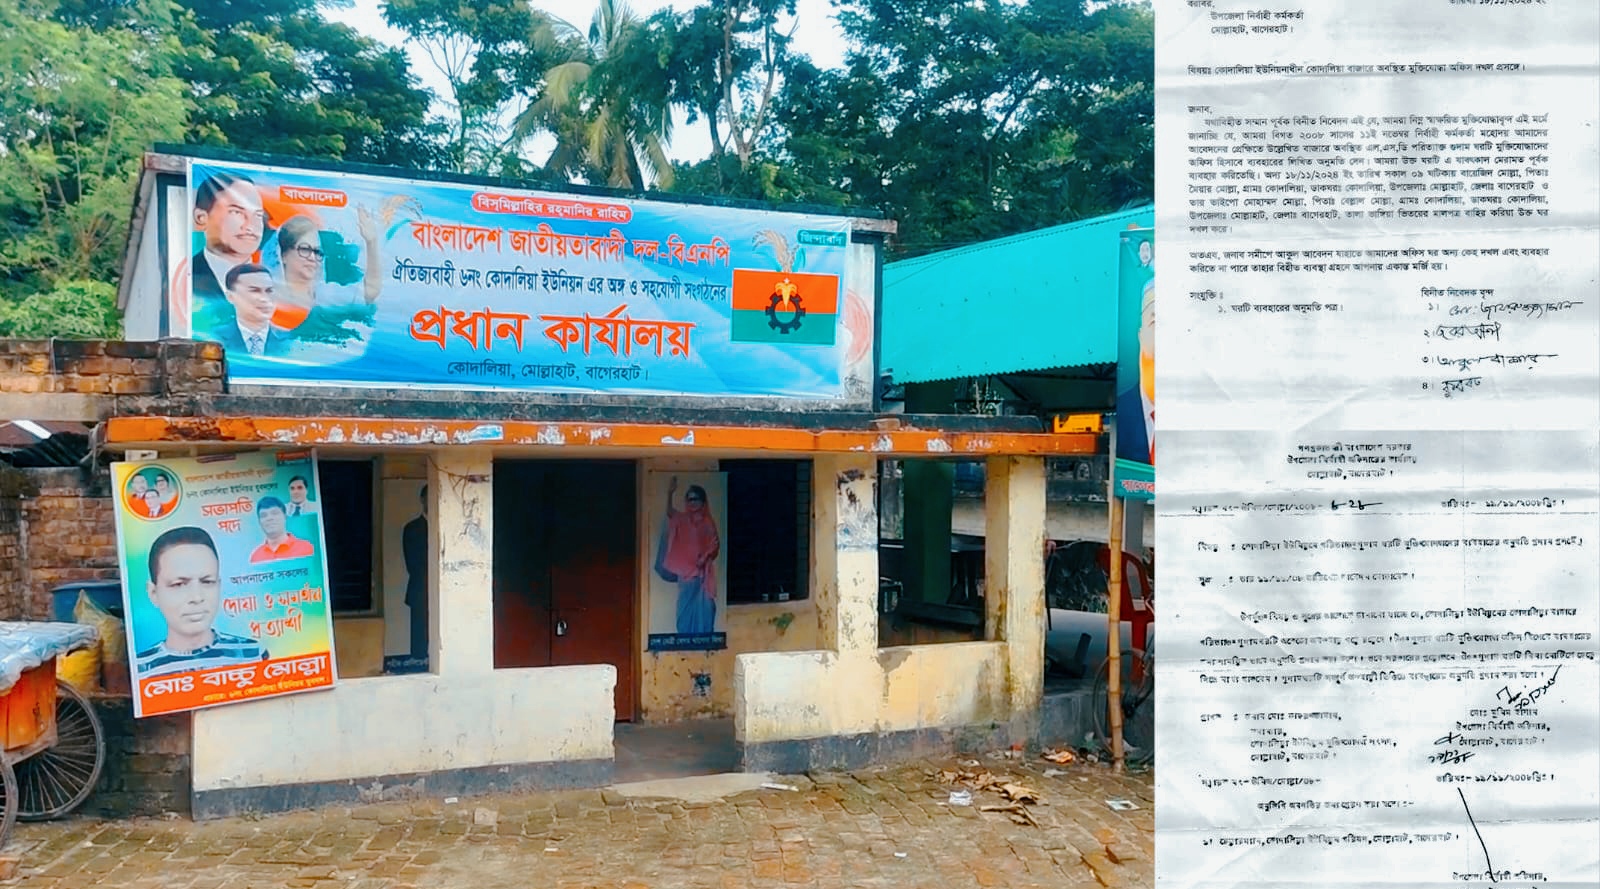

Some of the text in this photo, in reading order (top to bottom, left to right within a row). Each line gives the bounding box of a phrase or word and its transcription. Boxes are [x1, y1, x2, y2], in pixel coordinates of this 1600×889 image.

[1210, 9, 1305, 21] উপজেলা নির্বাহী কর্মকর্তা
[284, 187, 343, 204] বাংলাদেশ
[597, 206, 628, 219] রাহিম
[411, 221, 731, 266] বাংলাদেশ জাতীয়তাবাদী দল-বিএনপি
[800, 231, 843, 245] জিন্দাবাদ
[459, 269, 482, 289] ৬নং
[485, 266, 538, 292] কোদালিয়া
[541, 268, 584, 293] ইউনিয়ন
[587, 276, 604, 295] এর
[607, 277, 625, 296] অঙ্গ
[630, 281, 638, 295] ও
[641, 275, 682, 300] সহযোগী
[683, 278, 728, 302] সংগঠনের
[409, 304, 697, 357] প্রধান কার্যালয়
[447, 359, 515, 379] কোদালিয়া,
[521, 363, 580, 381] মোল্লাহাট,
[201, 497, 253, 518] সভাপতি
[217, 518, 241, 534] পদে
[230, 567, 309, 585] আপনাদের সকলের
[222, 595, 258, 616] দোয়া
[265, 594, 274, 609] ও
[144, 655, 328, 698] মোঃ বাচ্চু মোল্লা
